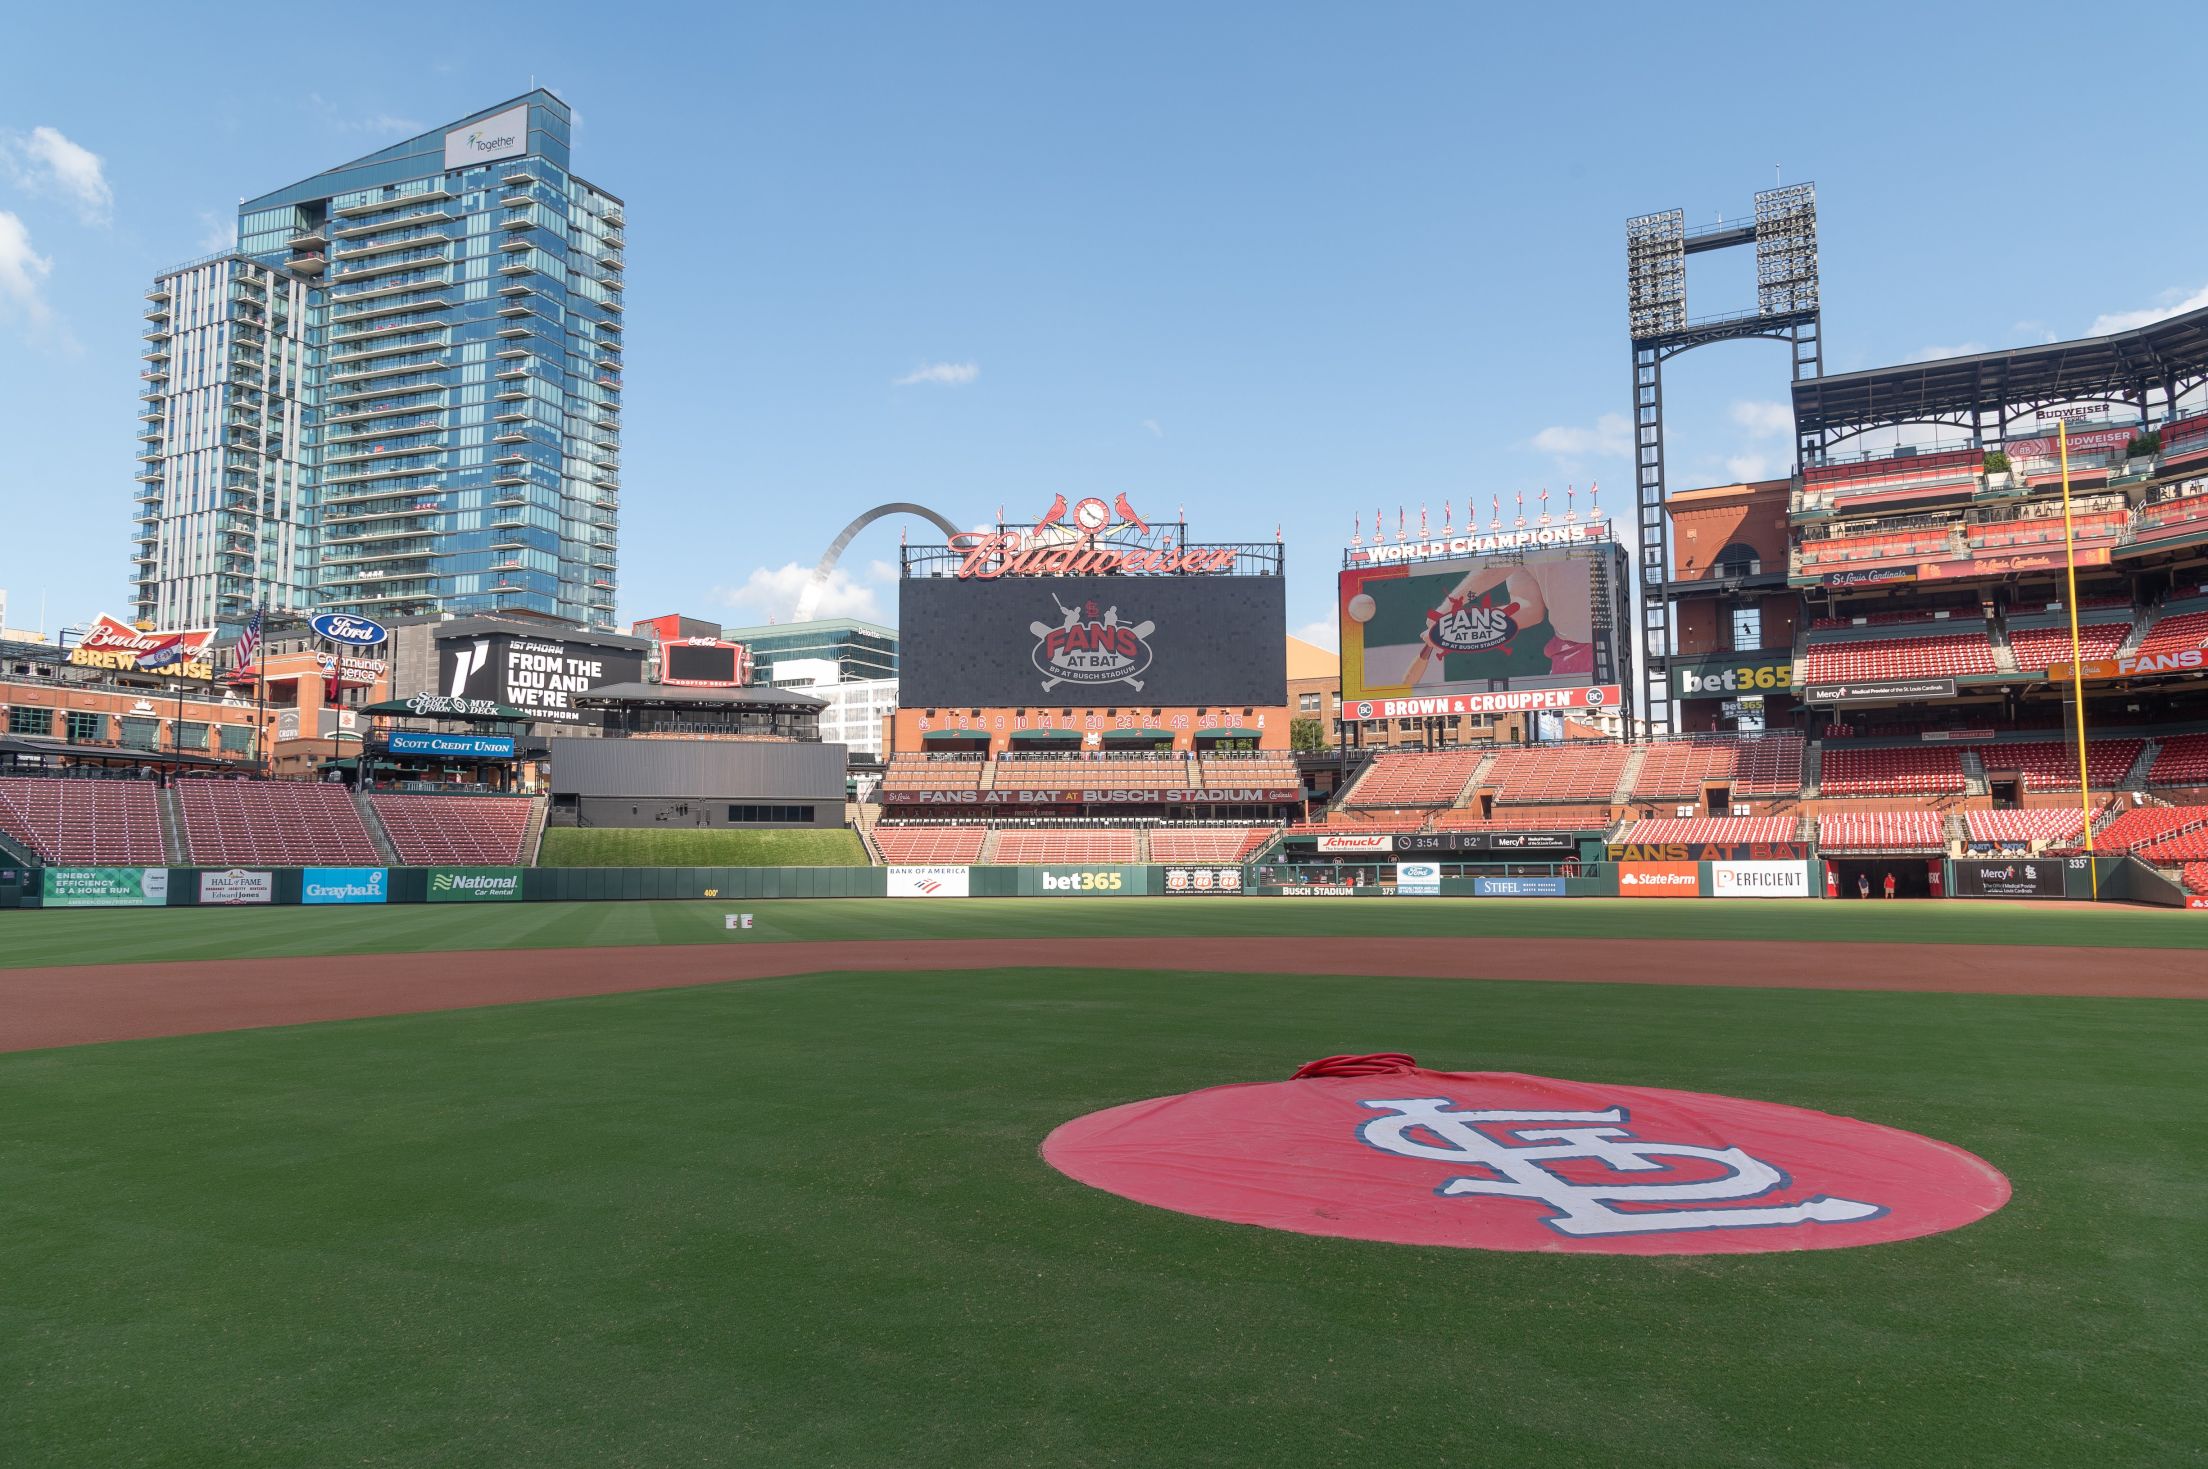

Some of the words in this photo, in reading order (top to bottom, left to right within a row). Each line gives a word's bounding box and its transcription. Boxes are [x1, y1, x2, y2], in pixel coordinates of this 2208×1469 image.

[476, 136, 515, 152] Together
[2036, 404, 2110, 419] BUDWEISER
[1366, 542, 1444, 562] WORLD
[1450, 526, 1586, 554] CHAMPIONS
[948, 531, 1238, 579] Budweiser
[1985, 560, 2009, 571] Louis
[2010, 557, 2050, 569] Cardinals
[1844, 572, 1866, 585] Louis
[1868, 570, 1906, 582] Cardinals
[328, 616, 373, 640] Ford
[1439, 608, 1507, 636] FANS
[688, 636, 717, 646] Coca-Cola
[1045, 623, 1137, 661] FANS
[1455, 632, 1468, 641] AT
[1471, 630, 1492, 640] BAT
[510, 640, 526, 650] 1ST
[526, 643, 564, 654] PHORM
[1480, 636, 1507, 649] STADIUM
[71, 648, 136, 671] BREW
[140, 660, 213, 680] OUSE
[316, 651, 386, 674] Community
[508, 652, 563, 674] FROM
[566, 659, 602, 678] THE
[1067, 655, 1086, 667] AT
[1090, 655, 1118, 667] BAT
[2118, 650, 2203, 674] FANS
[1049, 665, 1060, 673] BP
[1101, 665, 1136, 679] STADIUM
[507, 669, 545, 689] LOU
[548, 674, 589, 693] AND
[1682, 666, 1791, 693] bet365
[418, 692, 452, 703] SCOTT
[506, 686, 568, 708] WE'RE
[1587, 691, 1603, 702] BC
[1816, 690, 1840, 699] Mercy
[406, 698, 448, 709] CREDIT
[415, 705, 452, 715] UNION
[470, 699, 495, 708] MVP
[1359, 704, 1372, 715] BC
[1384, 699, 1449, 716] BROWN
[1454, 700, 1465, 712] &
[1471, 691, 1571, 711] CROUPPEN
[1722, 702, 1763, 711] bet365
[469, 706, 500, 715] DECK
[944, 716, 950, 730] 1
[959, 716, 968, 729] 2
[977, 716, 986, 730] 6
[996, 716, 1005, 729] 9
[1014, 716, 1027, 730] 10
[1038, 716, 1052, 729] 14
[1062, 716, 1076, 729] 17
[1086, 716, 1104, 729] 20
[1116, 716, 1133, 729] 23
[1142, 715, 1161, 729] 24
[1170, 715, 1188, 729] 42
[1199, 715, 1217, 729] 45
[1224, 715, 1242, 728] 85
[393, 737, 429, 748] SCOTT
[431, 739, 472, 751] CREDIT
[474, 741, 510, 752] UNION
[919, 790, 977, 803] FANS
[985, 790, 1013, 803] AT
[1019, 790, 1060, 803] BAT
[1083, 790, 1159, 802] BUSCH
[1166, 790, 1263, 801] STADIUM
[1269, 790, 1293, 799] Cardinals
[1416, 838, 1439, 848] 3:54
[1463, 837, 1480, 847] 82°
[1499, 838, 1520, 847] Mercy
[1607, 844, 1689, 862] FANS
[1700, 843, 1739, 861] AT
[1752, 842, 1809, 861] BAT
[2069, 859, 2087, 868] 335'
[1408, 866, 1428, 876] Ford
[1980, 868, 2007, 880] Mercy
[241, 878, 262, 886] FAME
[452, 875, 518, 889] National
[1042, 872, 1122, 890] bet365
[1171, 877, 1184, 886] 66
[1196, 877, 1209, 886] 66
[1221, 877, 1235, 886] 66
[1717, 869, 1802, 887] PERFICIENT
[1283, 887, 1311, 895] BUSCH
[1314, 887, 1354, 896] STADIUM
[1484, 881, 1520, 893] STIFEL
